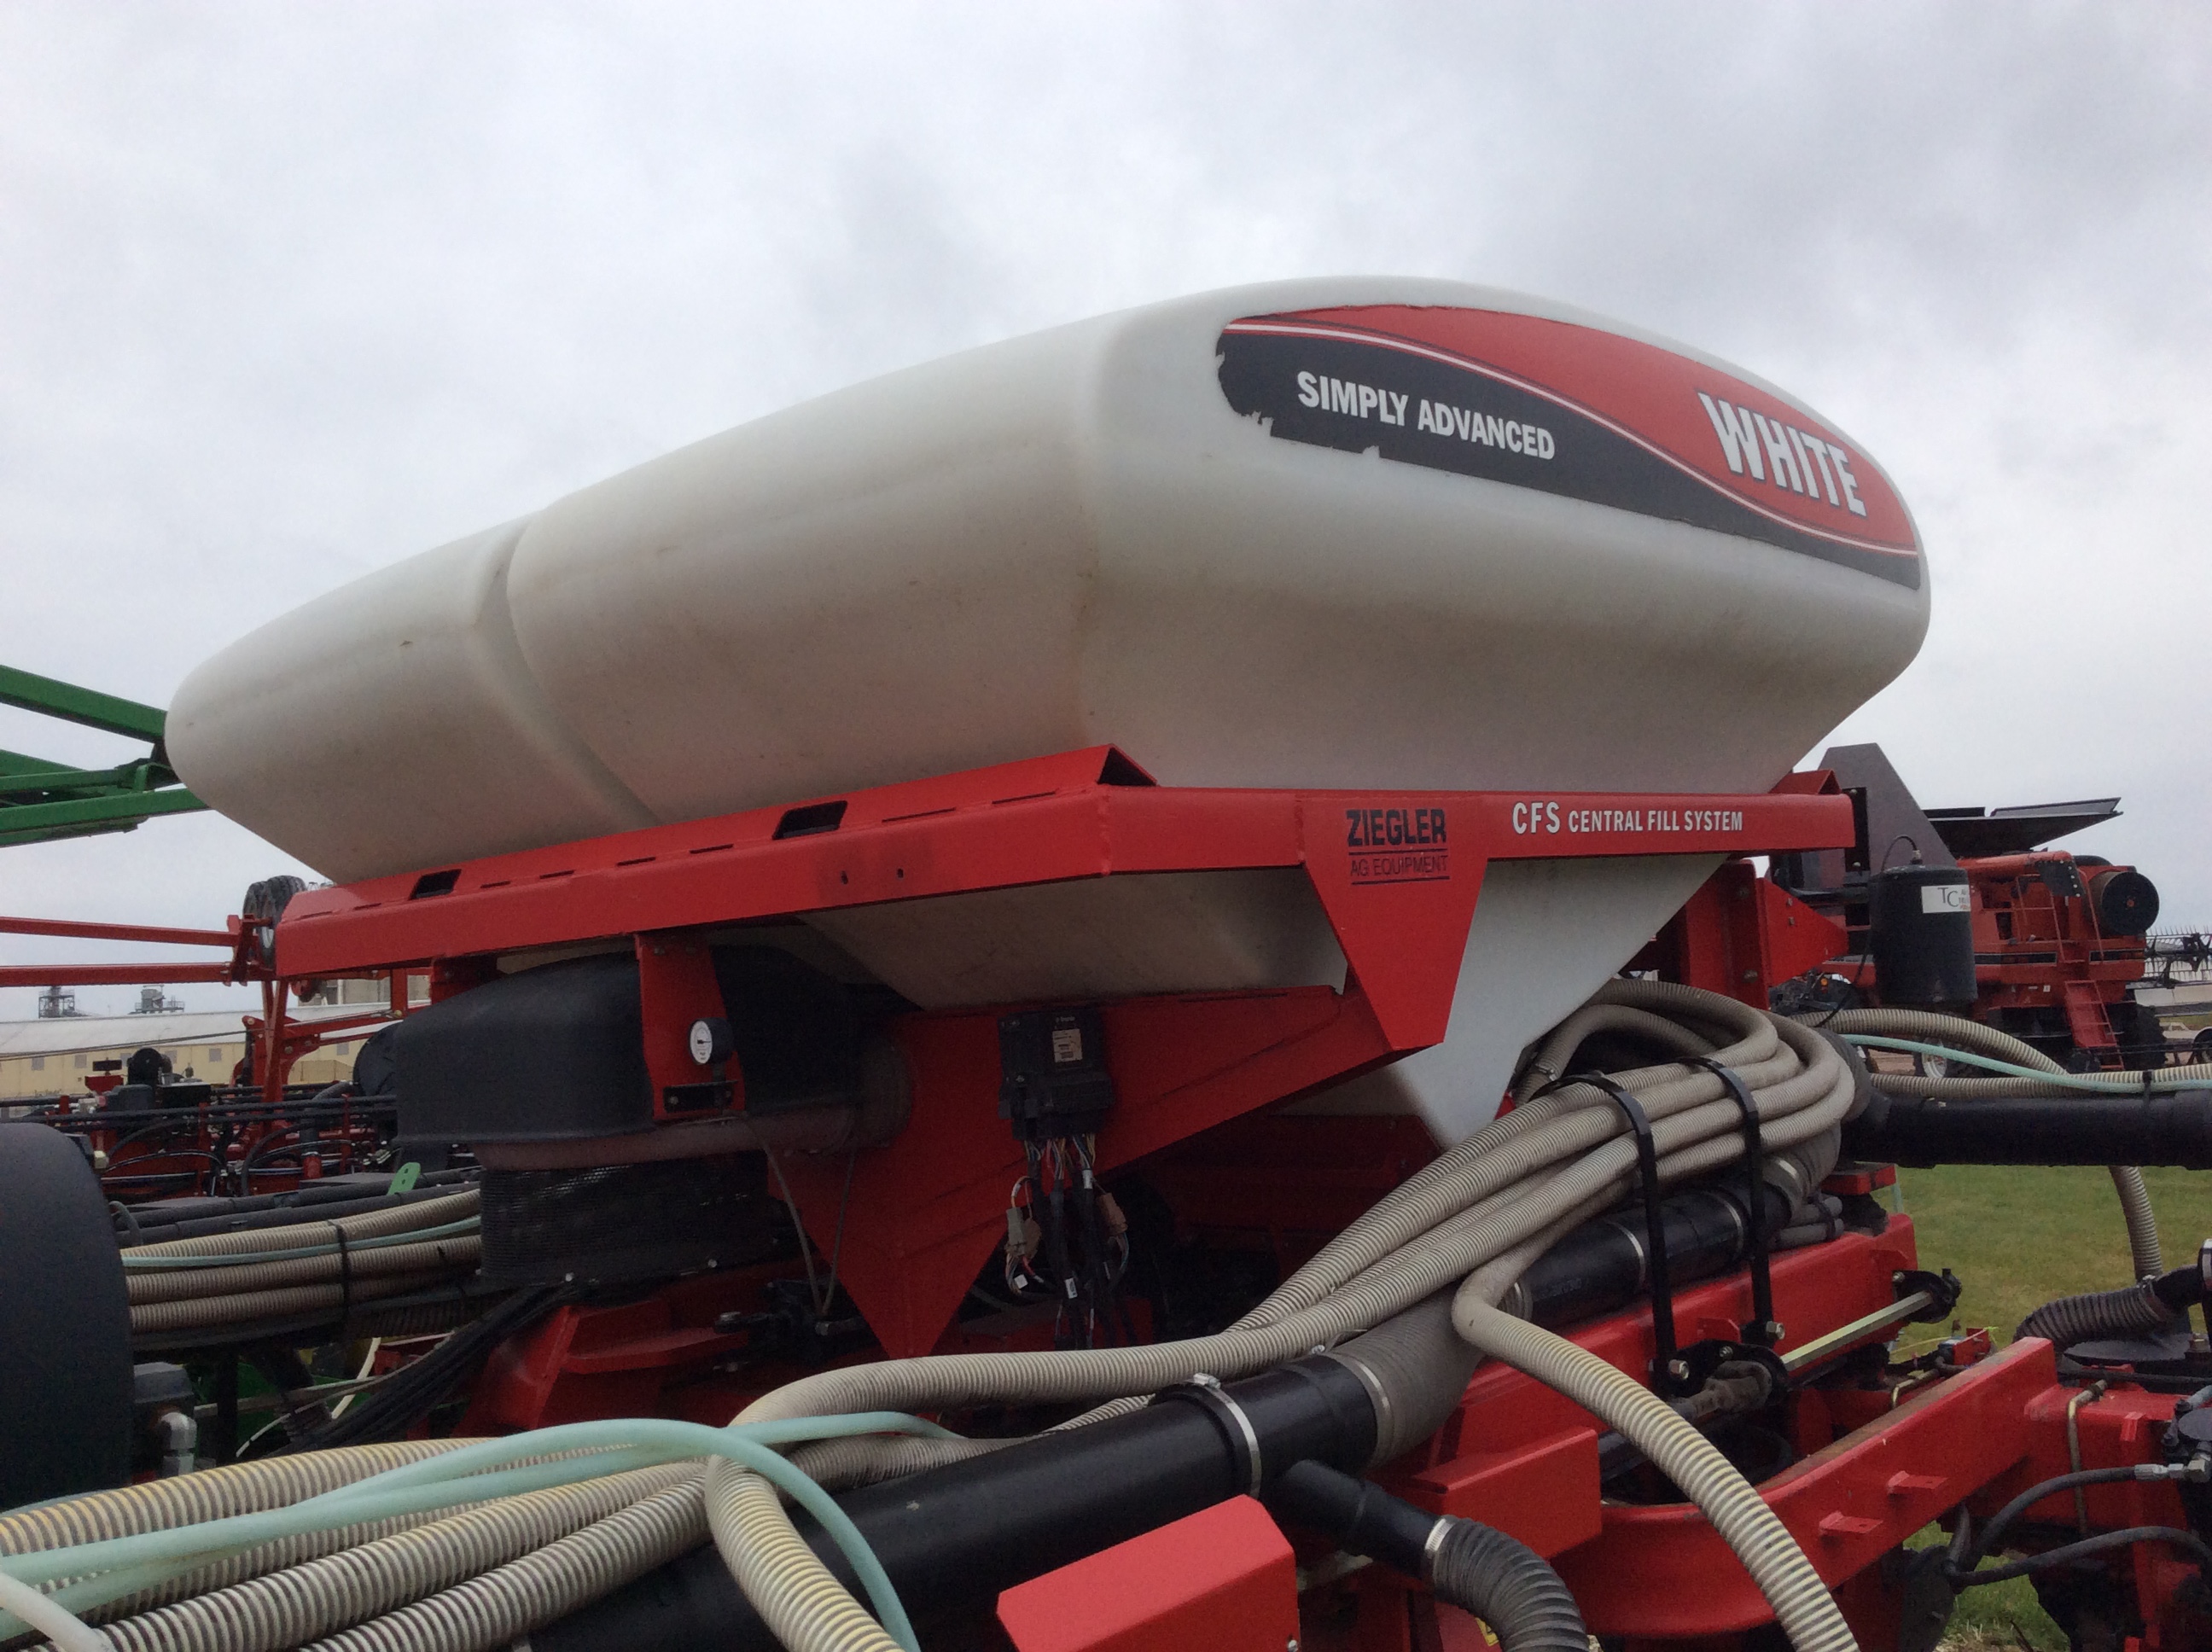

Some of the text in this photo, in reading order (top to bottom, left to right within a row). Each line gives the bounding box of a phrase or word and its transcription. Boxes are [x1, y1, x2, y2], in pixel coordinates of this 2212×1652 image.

[1297, 370, 1555, 460] SIMPLY ADVANCED
[1697, 391, 1866, 517] WHITE
[1346, 808, 1447, 846] ZIEGLER
[1512, 801, 1743, 835] CFS CENTRAL FILL SYSTEM
[1351, 855, 1449, 876] AG EQUIPMENT
